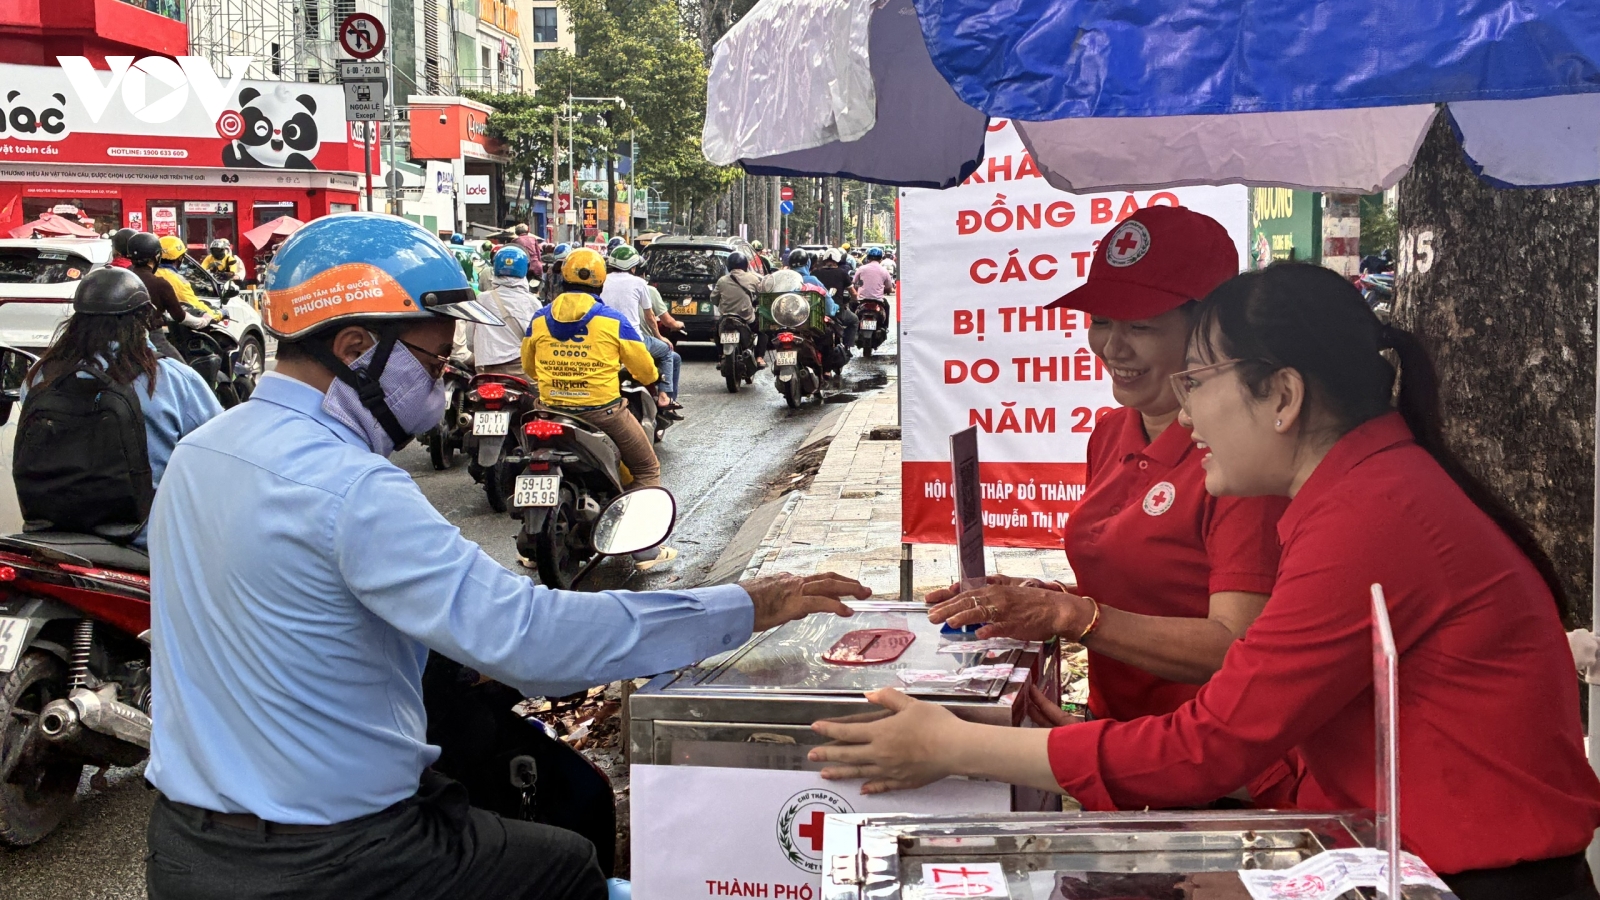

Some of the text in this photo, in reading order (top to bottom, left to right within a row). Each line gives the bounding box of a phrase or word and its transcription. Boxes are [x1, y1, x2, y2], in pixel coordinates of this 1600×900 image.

[0, 106, 65, 134] ac
[956, 193, 1076, 235] ĐỒNG
[970, 248, 1058, 284] CÁC
[294, 286, 384, 317] PHƯƠNG ĐÔNG
[313, 287, 328, 299] TÂM
[954, 308, 984, 342] BỊ
[944, 358, 999, 384] DO
[552, 379, 589, 391] Hygiene
[475, 425, 506, 434] 214.44
[969, 402, 1056, 434] NĂM
[522, 478, 552, 490] 59-L3
[924, 479, 946, 502] HỘI
[980, 480, 1013, 503] THẬP
[1018, 478, 1036, 500] ĐỎ
[517, 491, 555, 505] 035.96
[982, 508, 1027, 529] Nguyễn
[1031, 512, 1052, 532] Thị
[798, 793, 810, 803] CHỮ
[706, 878, 770, 897] THÀNH
[774, 882, 813, 900] PHỐ
